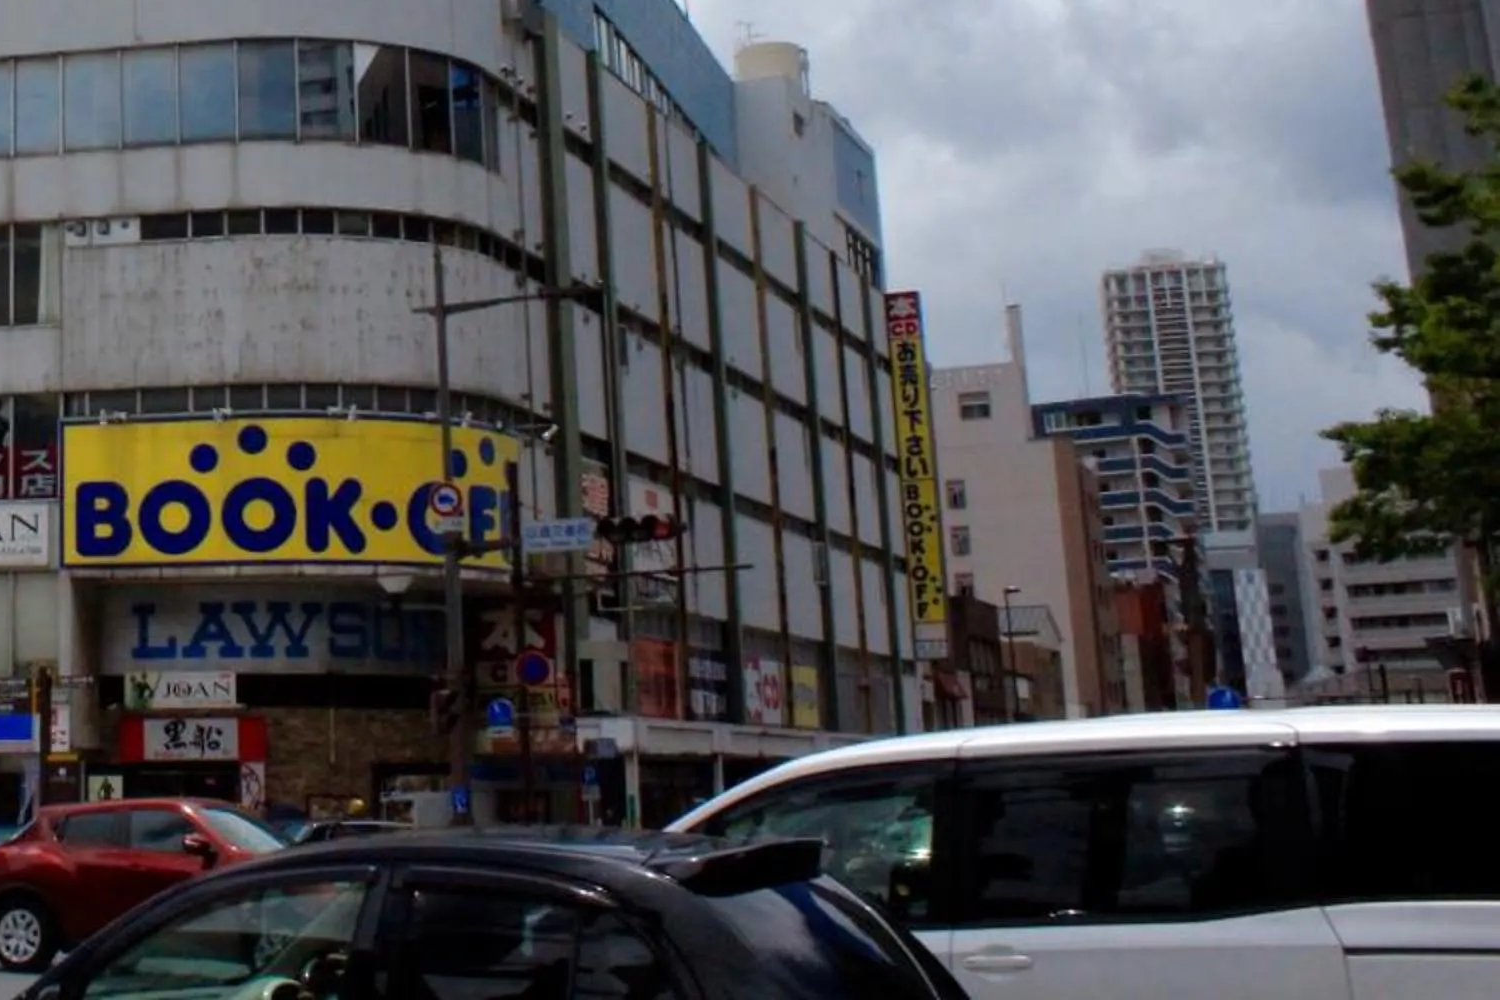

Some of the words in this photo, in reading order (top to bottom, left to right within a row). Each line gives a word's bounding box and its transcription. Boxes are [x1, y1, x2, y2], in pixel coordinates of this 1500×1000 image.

[891, 321, 918, 336] CD
[896, 342, 930, 478] お売り下さい
[163, 681, 231, 698] JOAN
[163, 718, 223, 753] 黒船
